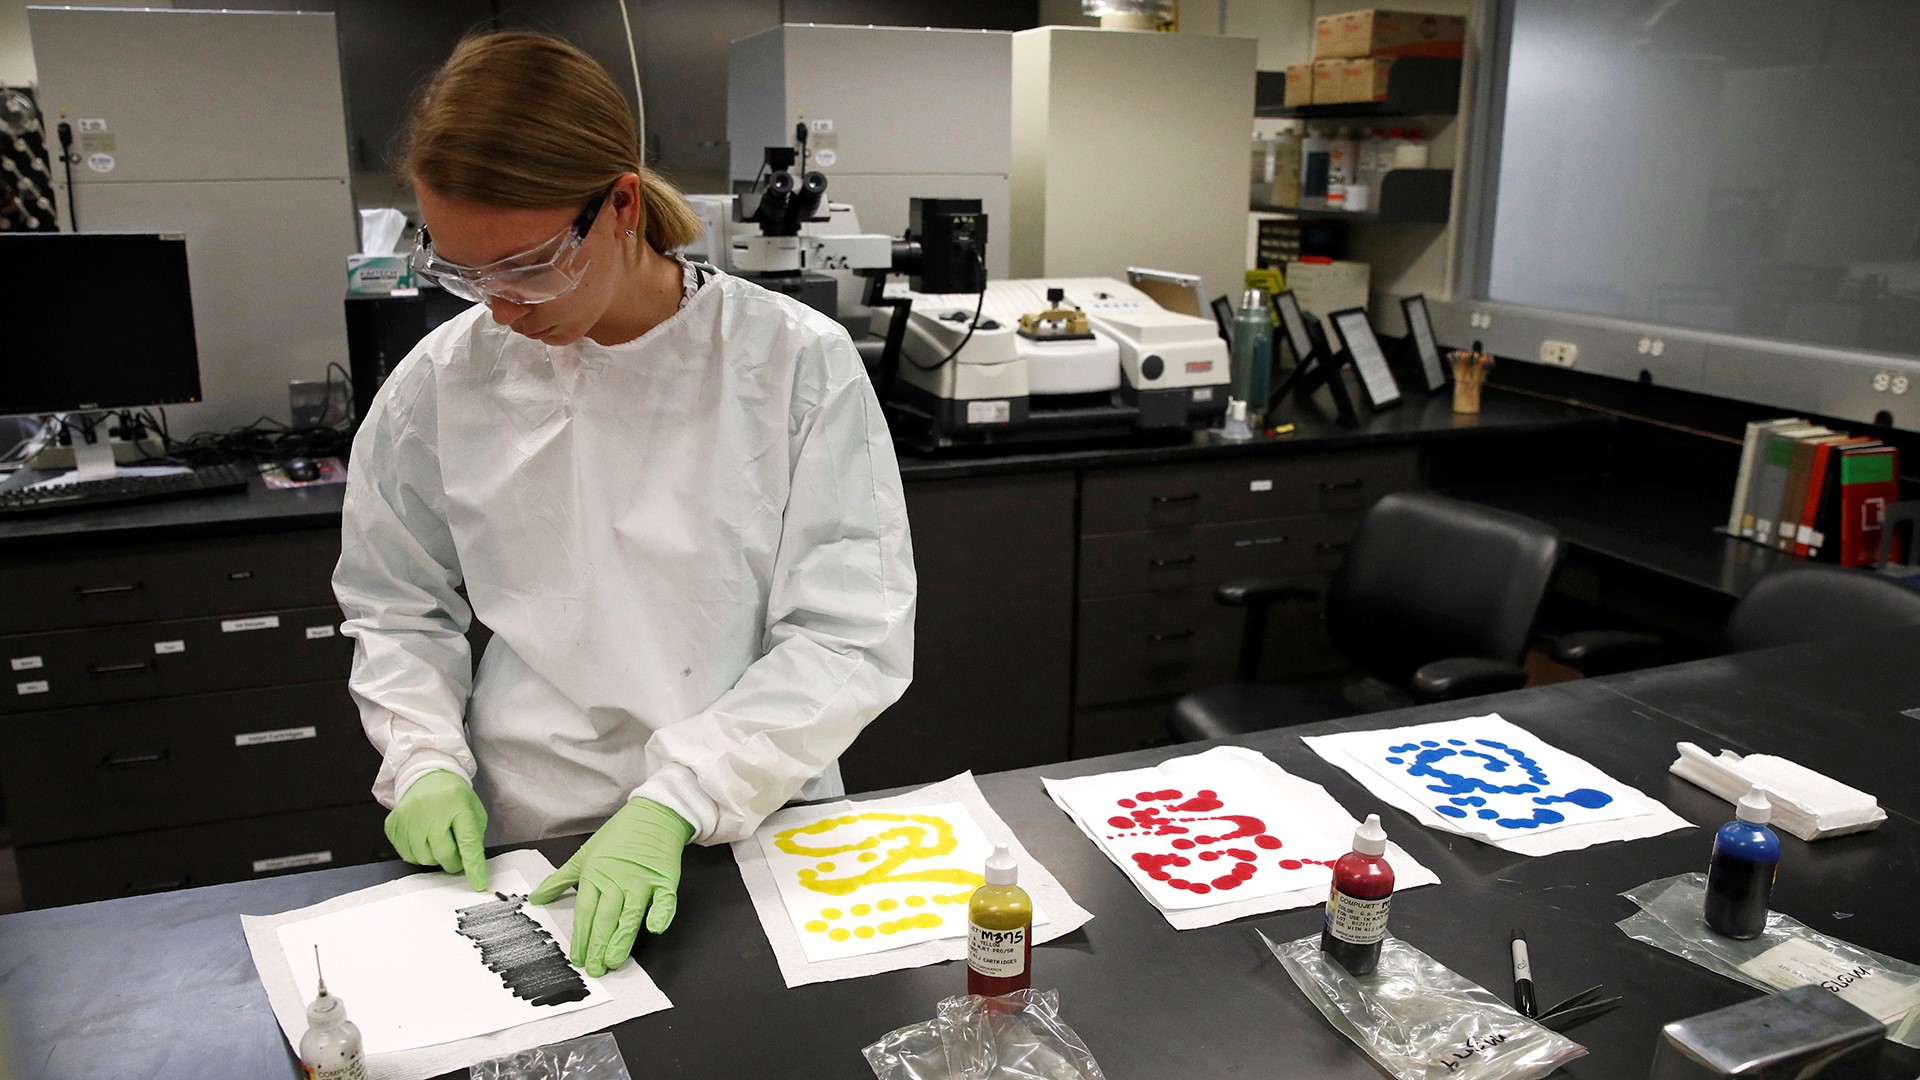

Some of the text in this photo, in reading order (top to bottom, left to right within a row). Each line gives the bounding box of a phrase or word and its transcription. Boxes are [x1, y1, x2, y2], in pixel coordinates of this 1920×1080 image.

[1340, 896, 1376, 909] COMPUJET
[982, 931, 1023, 944] M375
[980, 940, 1001, 948] YELLOW
[983, 957, 1017, 965] CARTRIDGES
